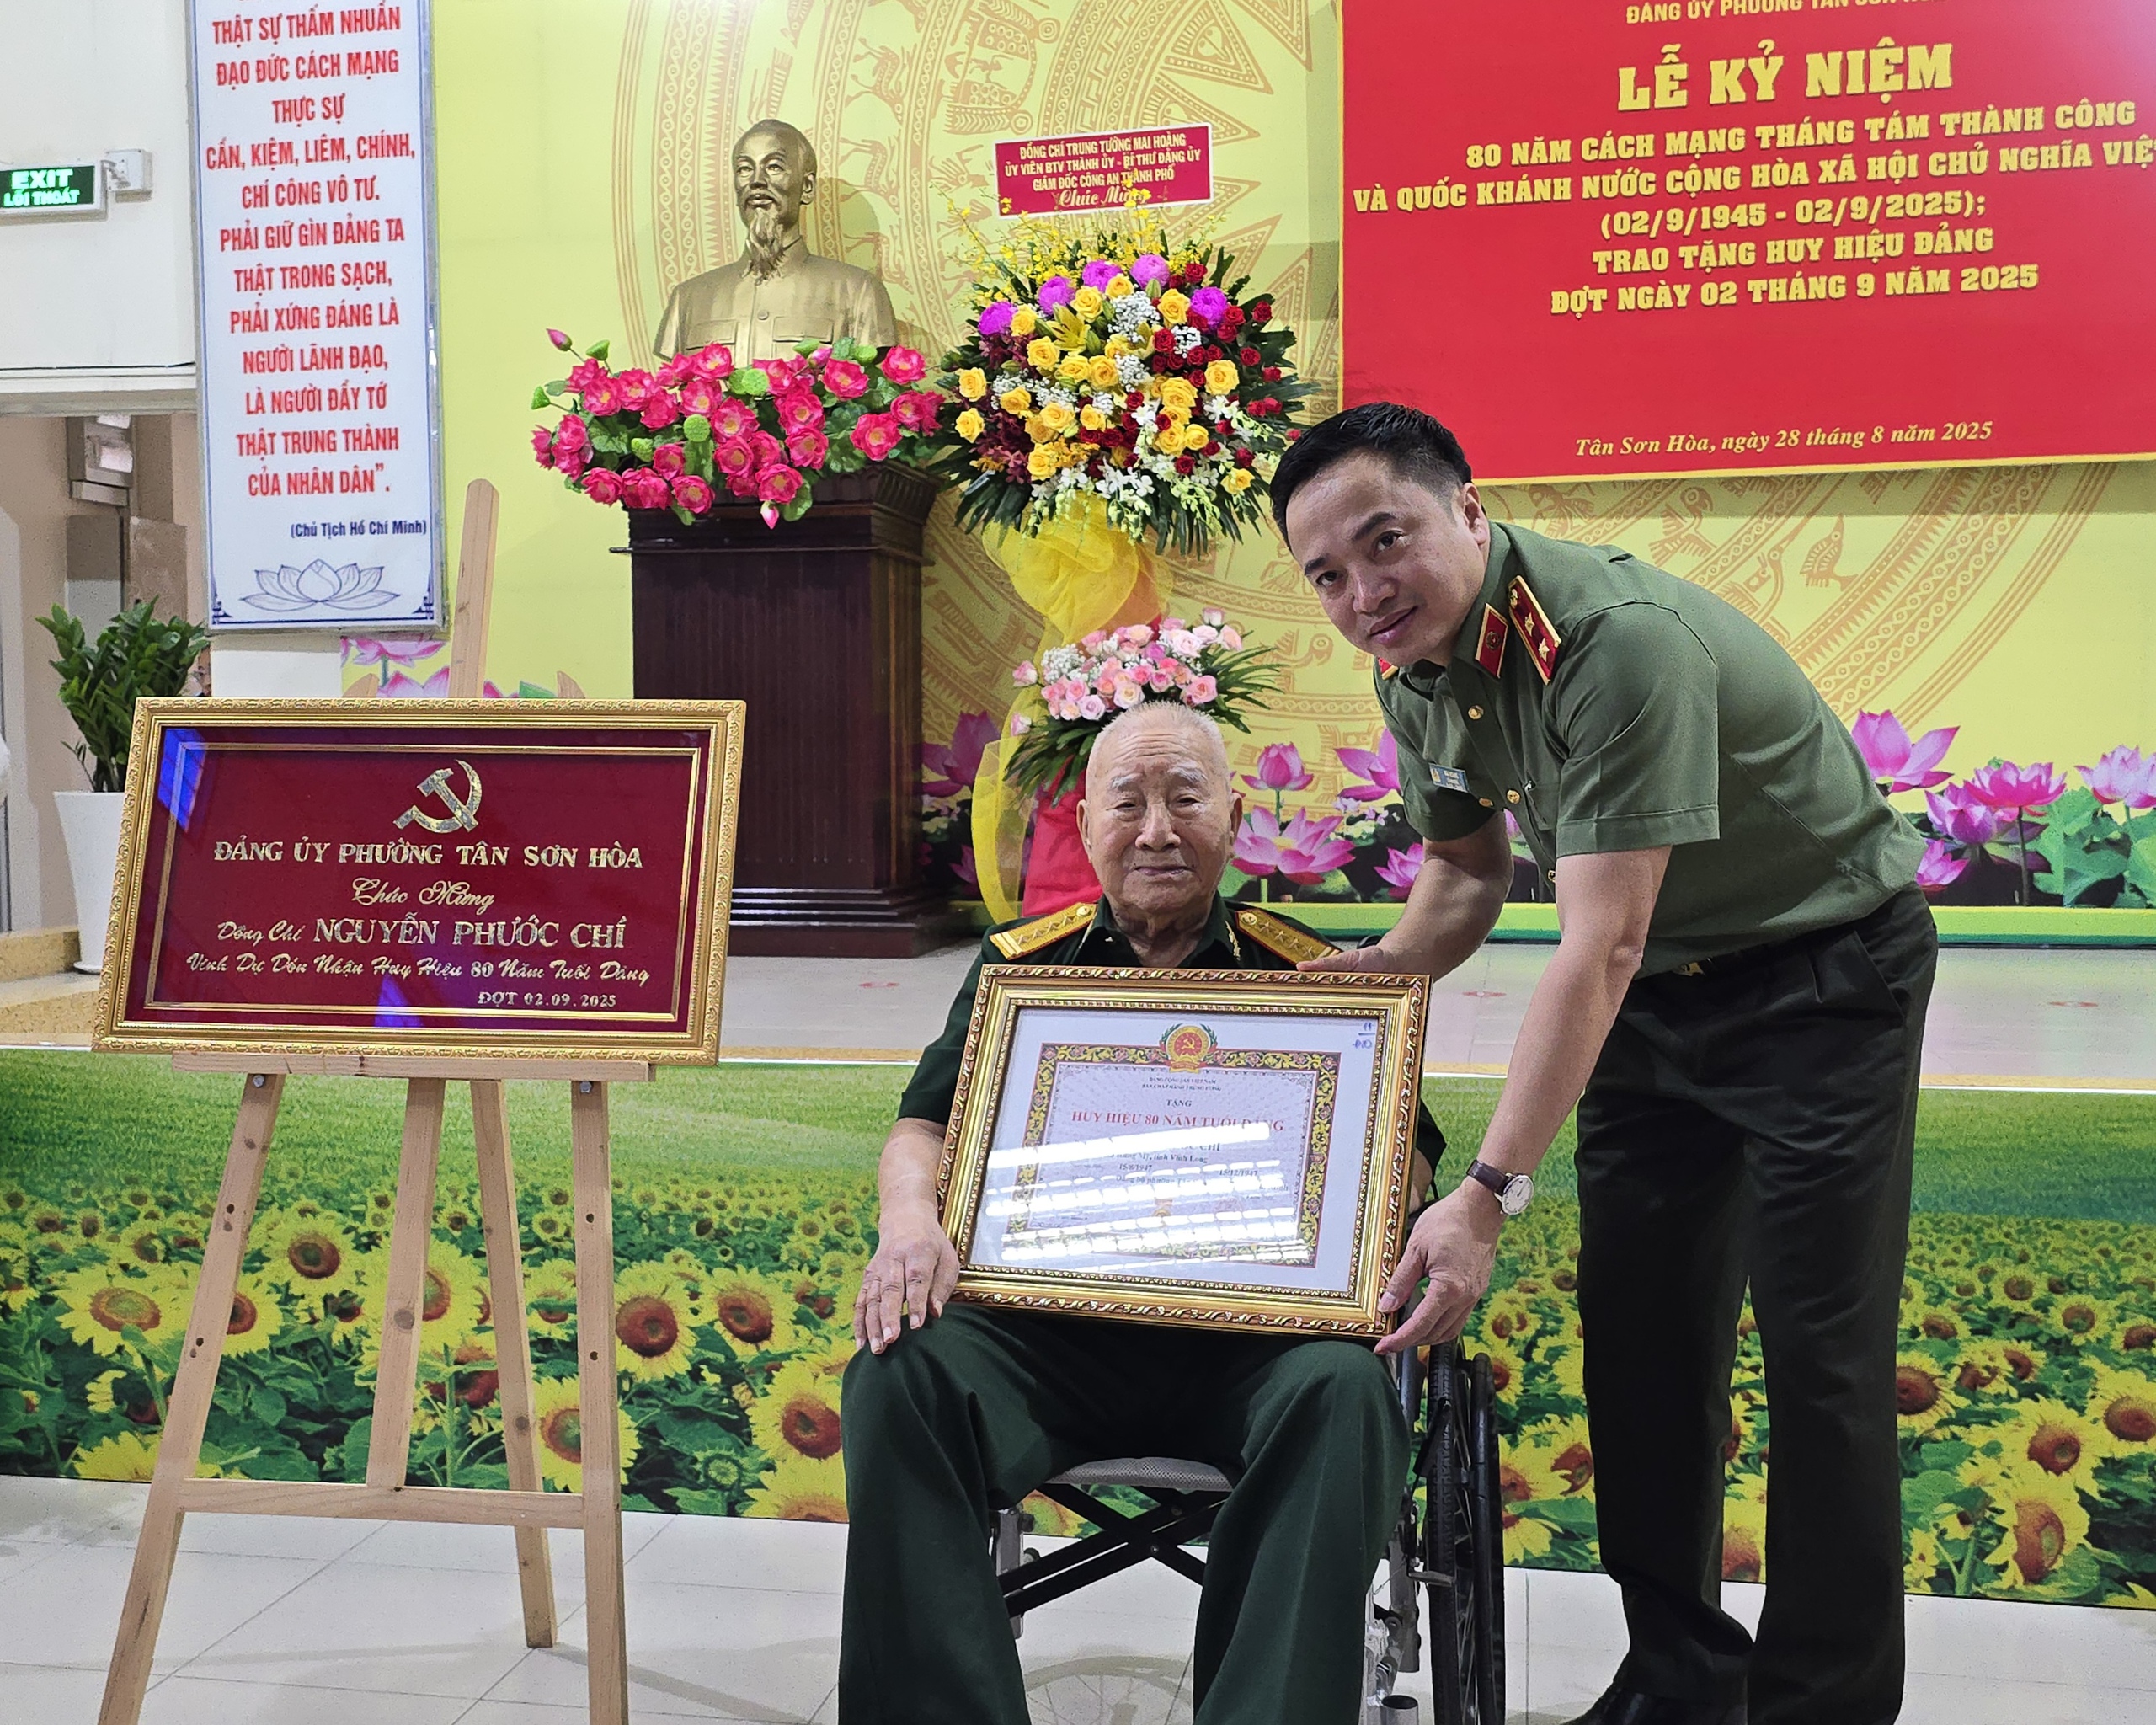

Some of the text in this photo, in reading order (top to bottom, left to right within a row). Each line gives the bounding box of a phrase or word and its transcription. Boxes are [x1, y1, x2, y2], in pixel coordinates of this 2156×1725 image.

[212, 14, 253, 48] THẬT
[259, 13, 282, 45] SỰ
[217, 49, 398, 90] ĐẠO ĐỨC CÁCH MẠNG
[1618, 35, 1953, 111] LỄ KỶ NIỆM
[272, 93, 345, 127] THỰC SỰ
[1048, 140, 1065, 158] CHÍ
[1065, 141, 1098, 156] TRUNG
[1133, 136, 1151, 151] MAI
[1153, 131, 1187, 148] HOÀNG
[1465, 97, 2136, 168] 80 NĂM CÁCH MẠNG THÁNG TÁM THÀNH CÔNG
[251, 137, 299, 171] KIỆM,
[305, 134, 350, 163] LIÊM,
[357, 130, 415, 159] CHÍNH,
[1020, 160, 1043, 175] VIÊN
[1045, 161, 1065, 174] BTV
[1066, 157, 1099, 172] THÀNH
[1136, 151, 1157, 166] THƯ
[11, 168, 73, 190] EXIT
[1033, 175, 1057, 191] GIÁM
[1059, 172, 1078, 190] ĐỐC
[1080, 172, 1105, 188] CÔNG
[1107, 173, 1120, 185] AN
[1155, 163, 1176, 181] PHỐ
[1353, 133, 2156, 212] VÀ QUỐC KHÁNH NƯỚC CỘNG HÒA XÃ HỘI CHỦ NGHĨA VIỆ
[242, 174, 380, 209] CHÍ CÔNG VÔ TƯ.
[1060, 189, 1099, 207] Chúc
[220, 212, 405, 252] PHẢI GIỮ GÌN ĐẢNG TA
[1601, 190, 1986, 239] (02/9/1945 - 02/9/2025);
[1593, 222, 1994, 274] TRAO TẶNG HUY HIỆU ĐẢNG
[234, 260, 392, 296] THẬT TRONG SẠCH,
[1550, 264, 2039, 318] ĐỢT NGÀY 02 THÁNG 9 NĂM 2025
[230, 296, 400, 334] PHẢI XỨNG ĐÁNG LÀ
[243, 343, 388, 374] NGƯỜI LÃNH ĐẠO,
[246, 387, 266, 414] LÀ
[270, 382, 322, 413] NGƯỜI
[366, 380, 387, 409] TỚ
[237, 423, 399, 461] THẬT TRUNG THÀNH
[1576, 421, 1993, 456] Tân Sơn Hòa, ngày 28 tháng 8 năm 2025
[248, 465, 281, 496] CỦA
[287, 466, 334, 495] NHÂN
[321, 521, 346, 539] Tịch
[369, 520, 389, 535] Chí
[392, 520, 427, 536] Minh)
[214, 835, 643, 868] ĐẢNG ỦY PHƯỜNG TÂN SƠN HÒA
[351, 877, 408, 905] Chúc
[268, 920, 306, 942] Chí
[312, 911, 440, 944] NGUYỄN
[452, 914, 559, 947] PHƯỚC
[570, 915, 627, 948] CHÍ
[186, 953, 229, 972] Vinh
[371, 956, 412, 980] Huy
[416, 957, 462, 980] Hiệu
[471, 961, 494, 978] 80
[498, 959, 545, 979] Năm
[478, 991, 518, 1008] ĐỢT
[1071, 1111, 1102, 1123] HUY
[1106, 1112, 1142, 1128] HIỆU
[1145, 1114, 1159, 1125] 80
[1162, 1112, 1197, 1127] NĂM
